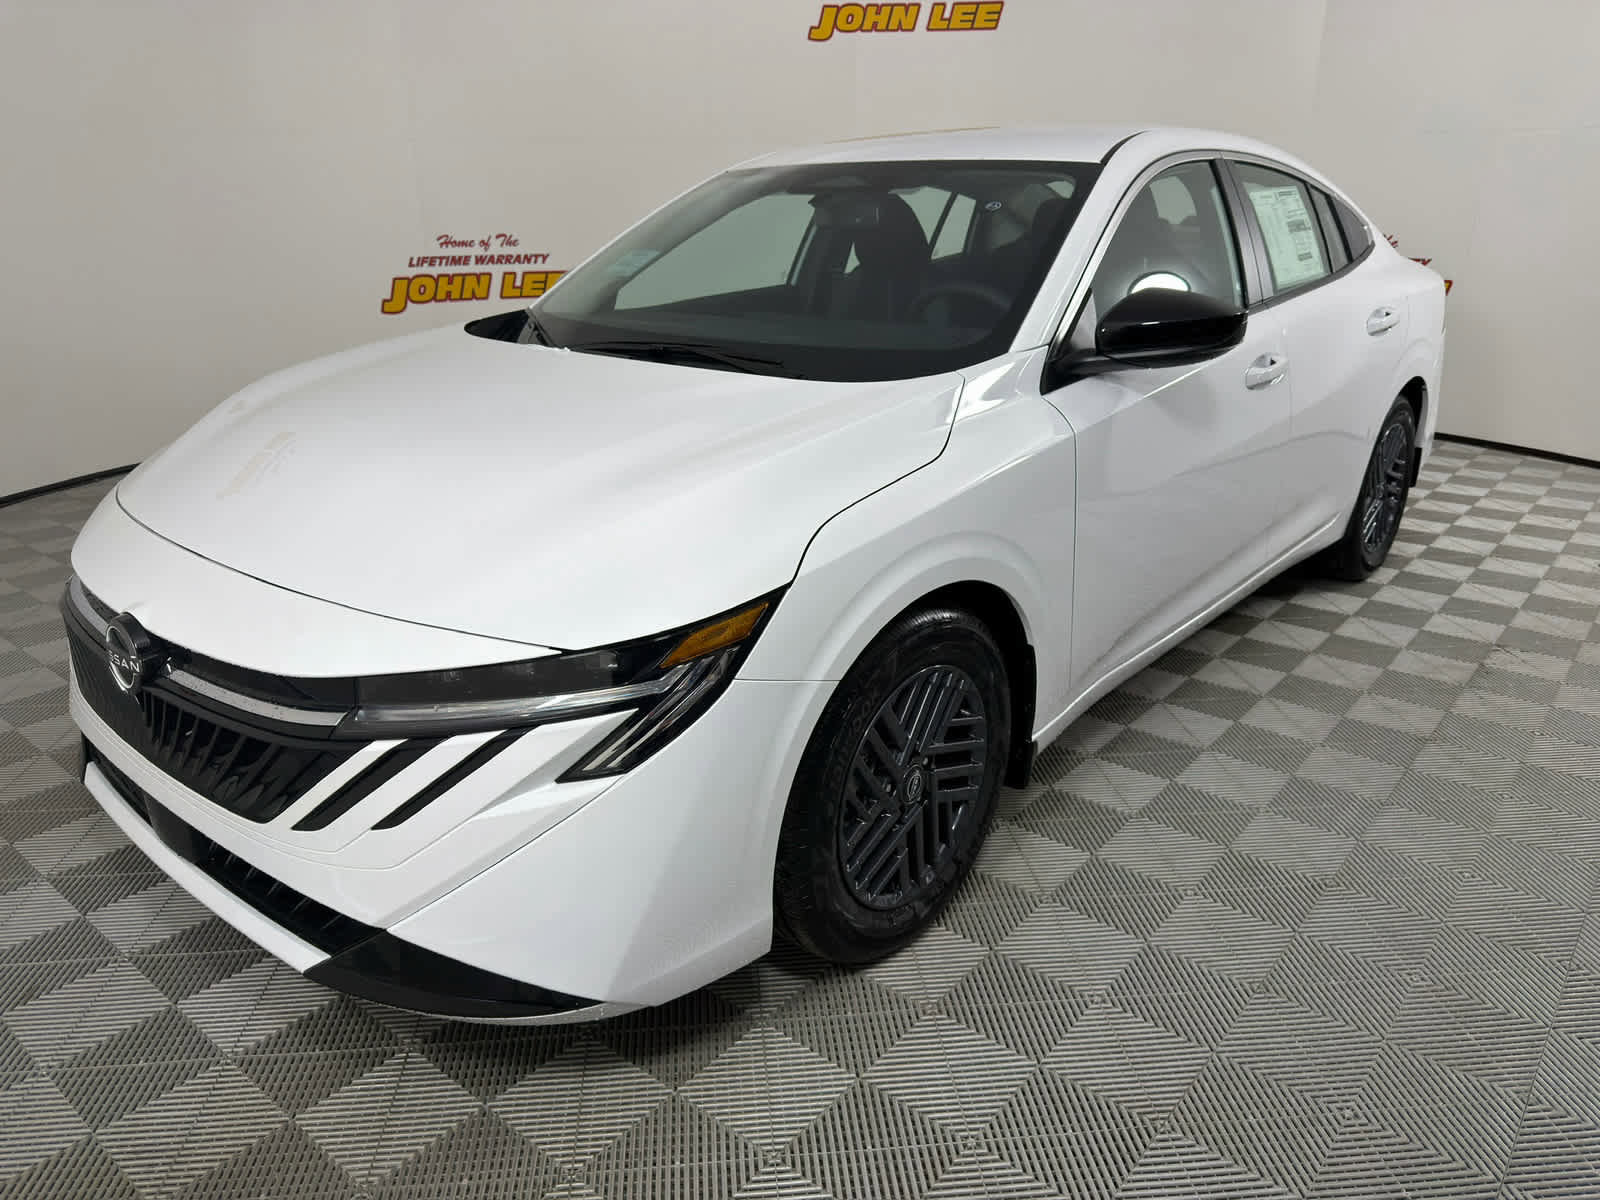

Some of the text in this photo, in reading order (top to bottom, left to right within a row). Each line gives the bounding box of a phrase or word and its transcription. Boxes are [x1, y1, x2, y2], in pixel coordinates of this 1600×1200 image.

[807, 1, 1004, 42] JOHN LEE
[436, 233, 520, 252] Home of The
[408, 253, 550, 268] LIFETIME WARRANTY
[381, 272, 492, 315] JOHN
